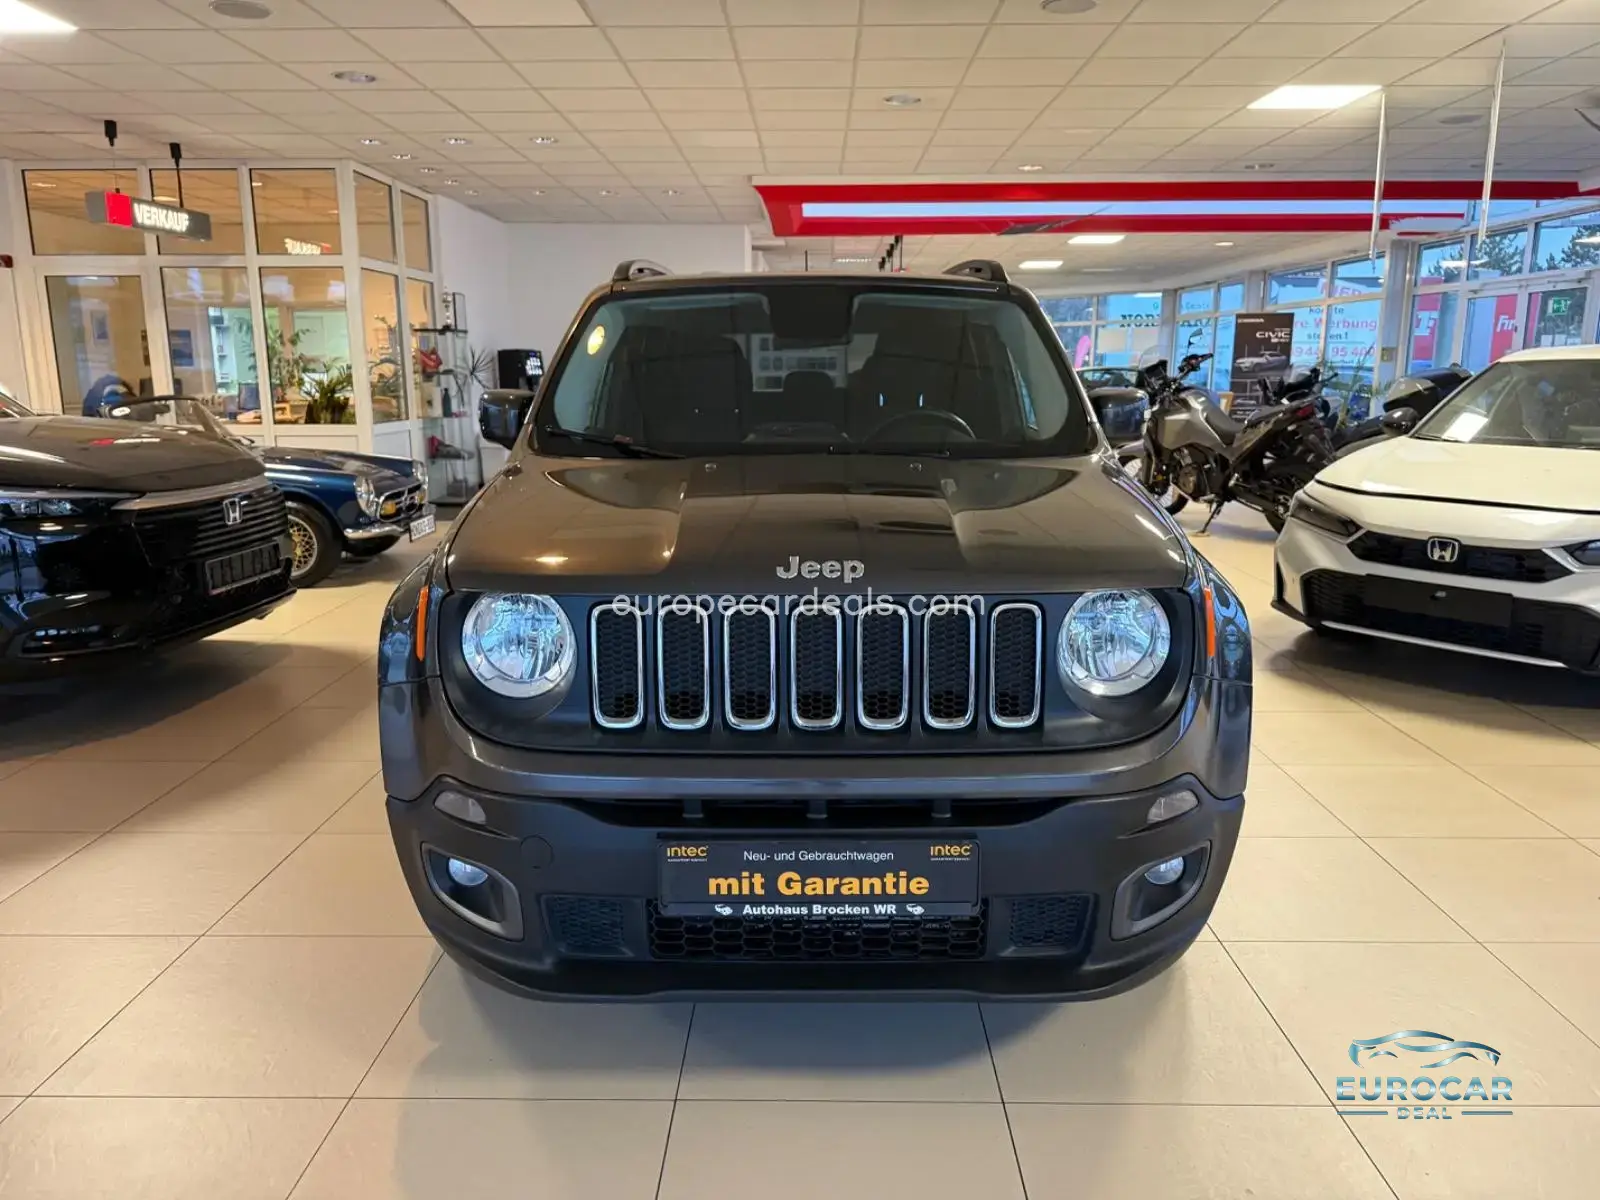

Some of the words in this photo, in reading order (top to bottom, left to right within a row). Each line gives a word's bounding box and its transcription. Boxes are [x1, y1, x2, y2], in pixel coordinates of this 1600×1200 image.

[133, 203, 190, 232] VERKAUF
[1314, 318, 1377, 331] Wrbung
[1255, 331, 1291, 339] CIVIC
[776, 555, 865, 584] Jeep
[666, 845, 708, 857] intec
[743, 850, 771, 861] Neu-
[774, 851, 796, 861] und
[798, 851, 894, 863] Gebrauchtwagen
[930, 844, 972, 856] intec
[708, 871, 765, 896] mit
[777, 870, 930, 896] Garantie
[742, 904, 809, 915] Autohaus
[812, 904, 870, 915] Brocken
[873, 905, 897, 914] WR
